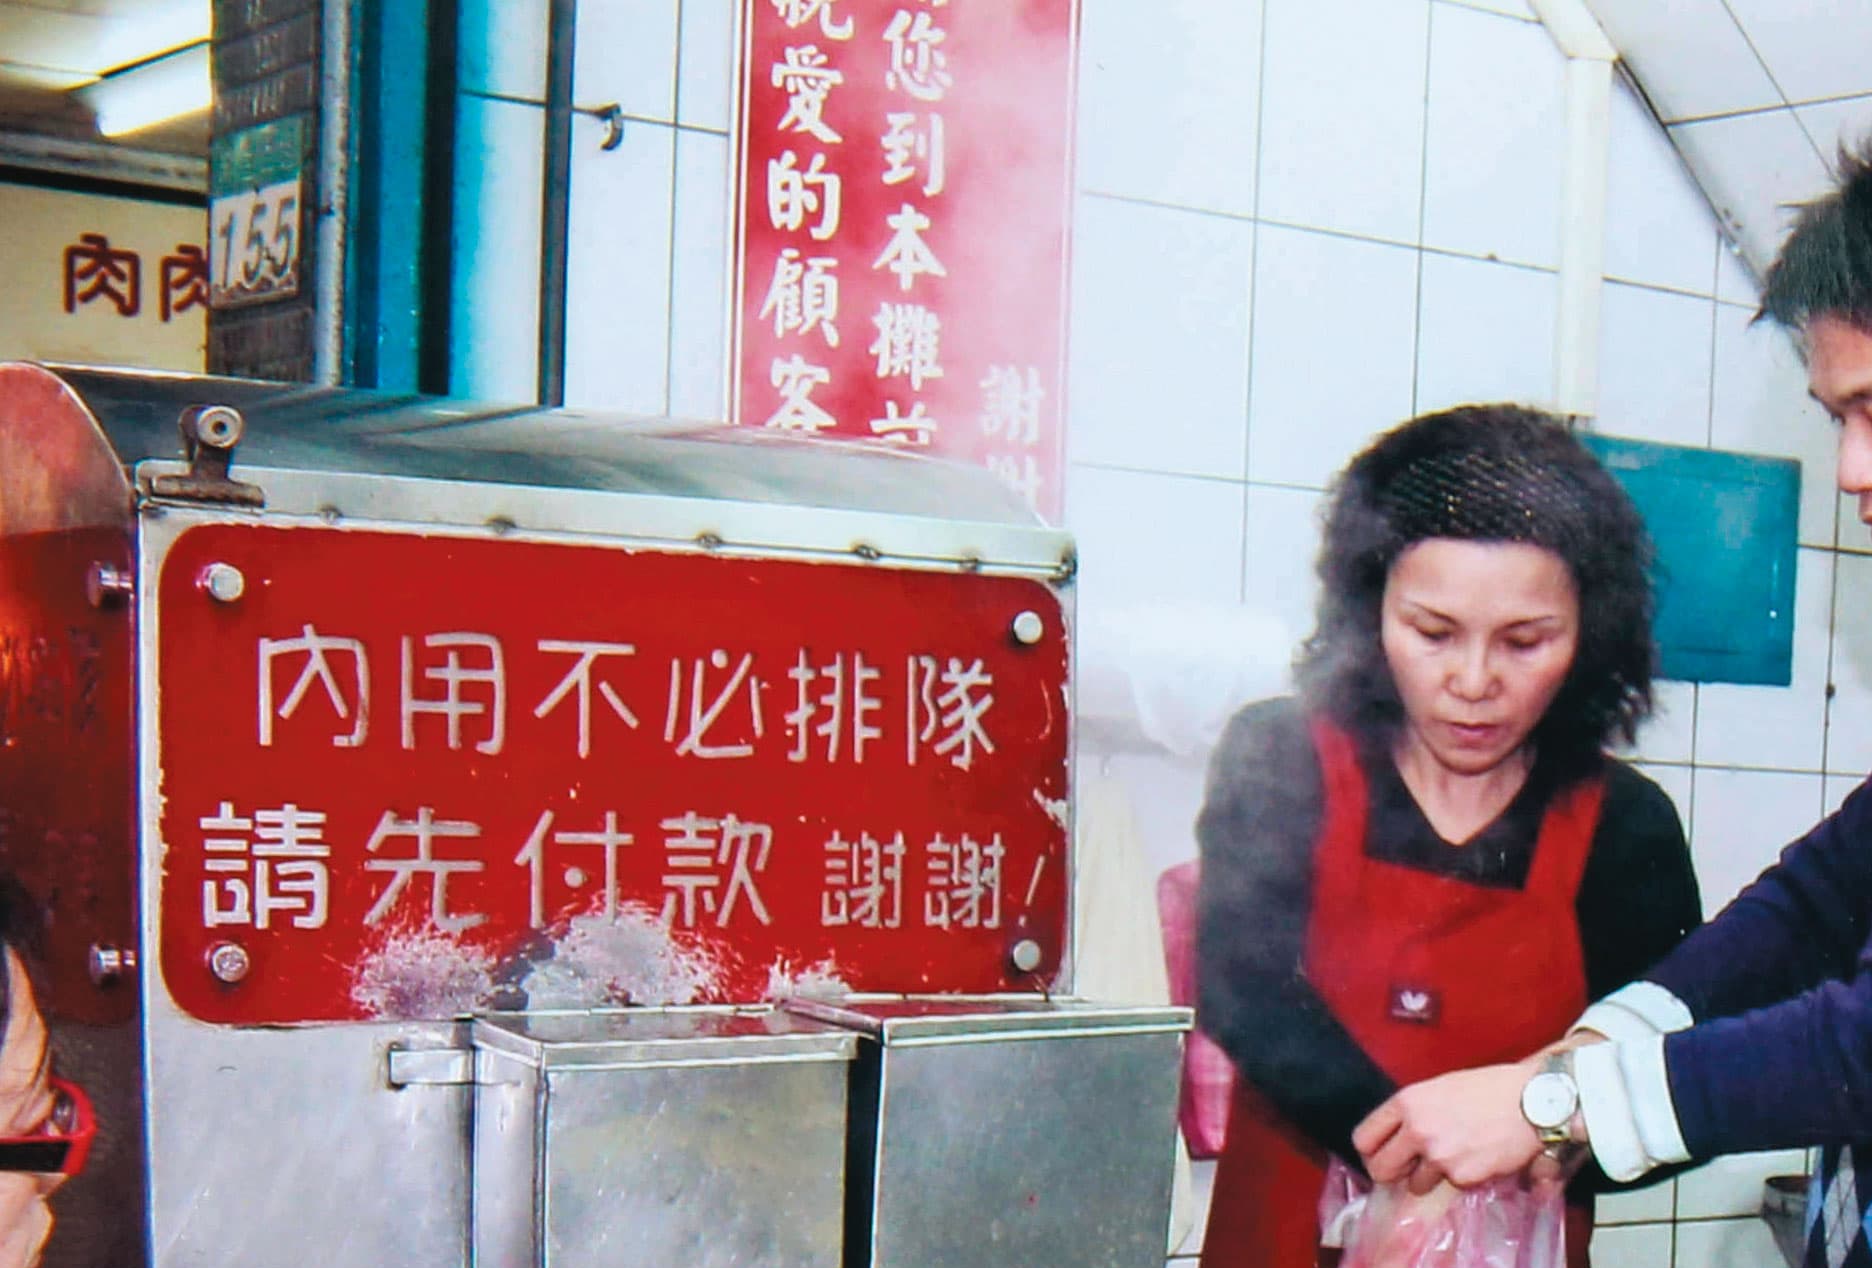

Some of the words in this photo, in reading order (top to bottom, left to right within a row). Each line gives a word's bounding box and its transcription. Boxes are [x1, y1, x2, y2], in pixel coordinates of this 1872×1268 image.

[218, 196, 297, 290] 155
[868, 0, 953, 445] 您到本攤
[200, 802, 773, 930] 請先付款
